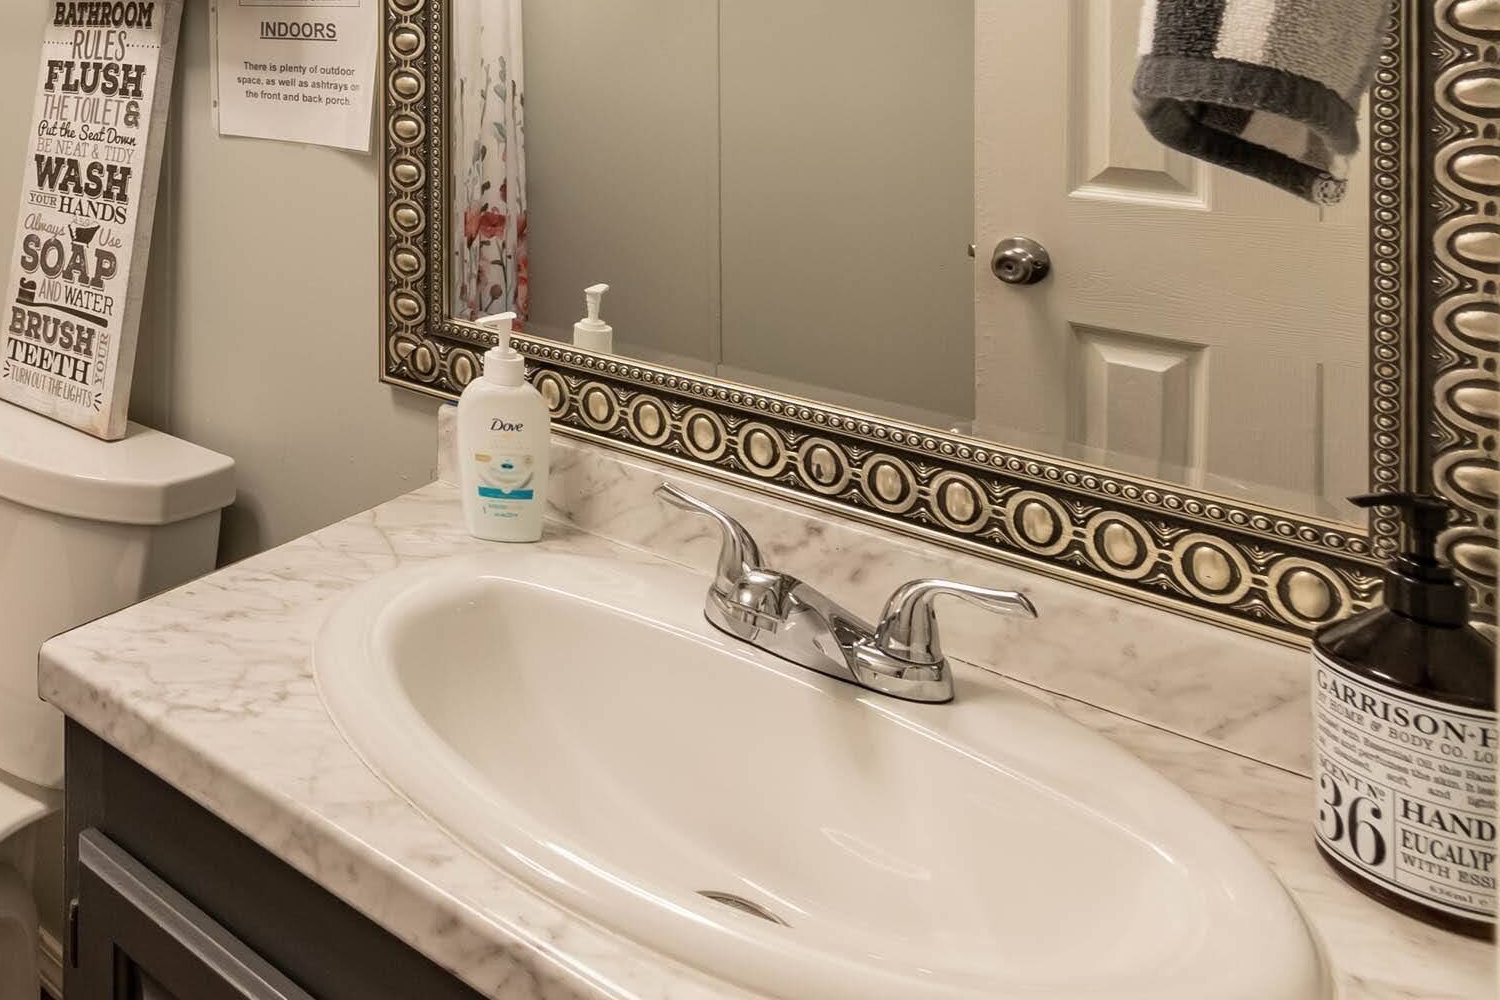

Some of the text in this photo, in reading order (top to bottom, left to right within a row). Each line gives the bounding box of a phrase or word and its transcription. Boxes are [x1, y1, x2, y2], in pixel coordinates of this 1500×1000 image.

[54, 1, 155, 28] BATHROOM
[260, 21, 337, 39] INDOORS
[71, 29, 127, 62] RULES
[44, 60, 146, 99] FLUSH
[243, 61, 356, 76] There is plenty of outdoor
[265, 78, 276, 86] as
[278, 78, 296, 87] well
[298, 80, 309, 88] as
[310, 80, 349, 92] ashtrays
[43, 94, 140, 129] THE TOILET &
[245, 90, 259, 99] the
[260, 90, 281, 100] front
[282, 93, 300, 102] and
[302, 93, 324, 103] back
[38, 119, 58, 137] Put
[59, 121, 77, 139] the
[79, 124, 106, 141] Seat
[36, 137, 136, 165] BE NEAT & TIDY
[34, 153, 133, 205] WASH
[29, 192, 128, 225] YOUR HANDS
[24, 212, 123, 249] Always Use
[20, 233, 118, 292] SOAP
[38, 278, 115, 317] AND WATER
[8, 305, 96, 359] BRUSH
[7, 337, 92, 386] TEETH
[94, 332, 110, 386] YOUR
[11, 365, 93, 408] TURN OUT THE LIGHTS
[490, 418, 524, 432] Dove
[1388, 727, 1434, 751] BODY
[1473, 750, 1497, 765] LO
[1319, 772, 1387, 868] 36
[1400, 798, 1497, 842] HAND
[1401, 828, 1497, 872] EUCALYP
[1401, 852, 1450, 880] WITH
